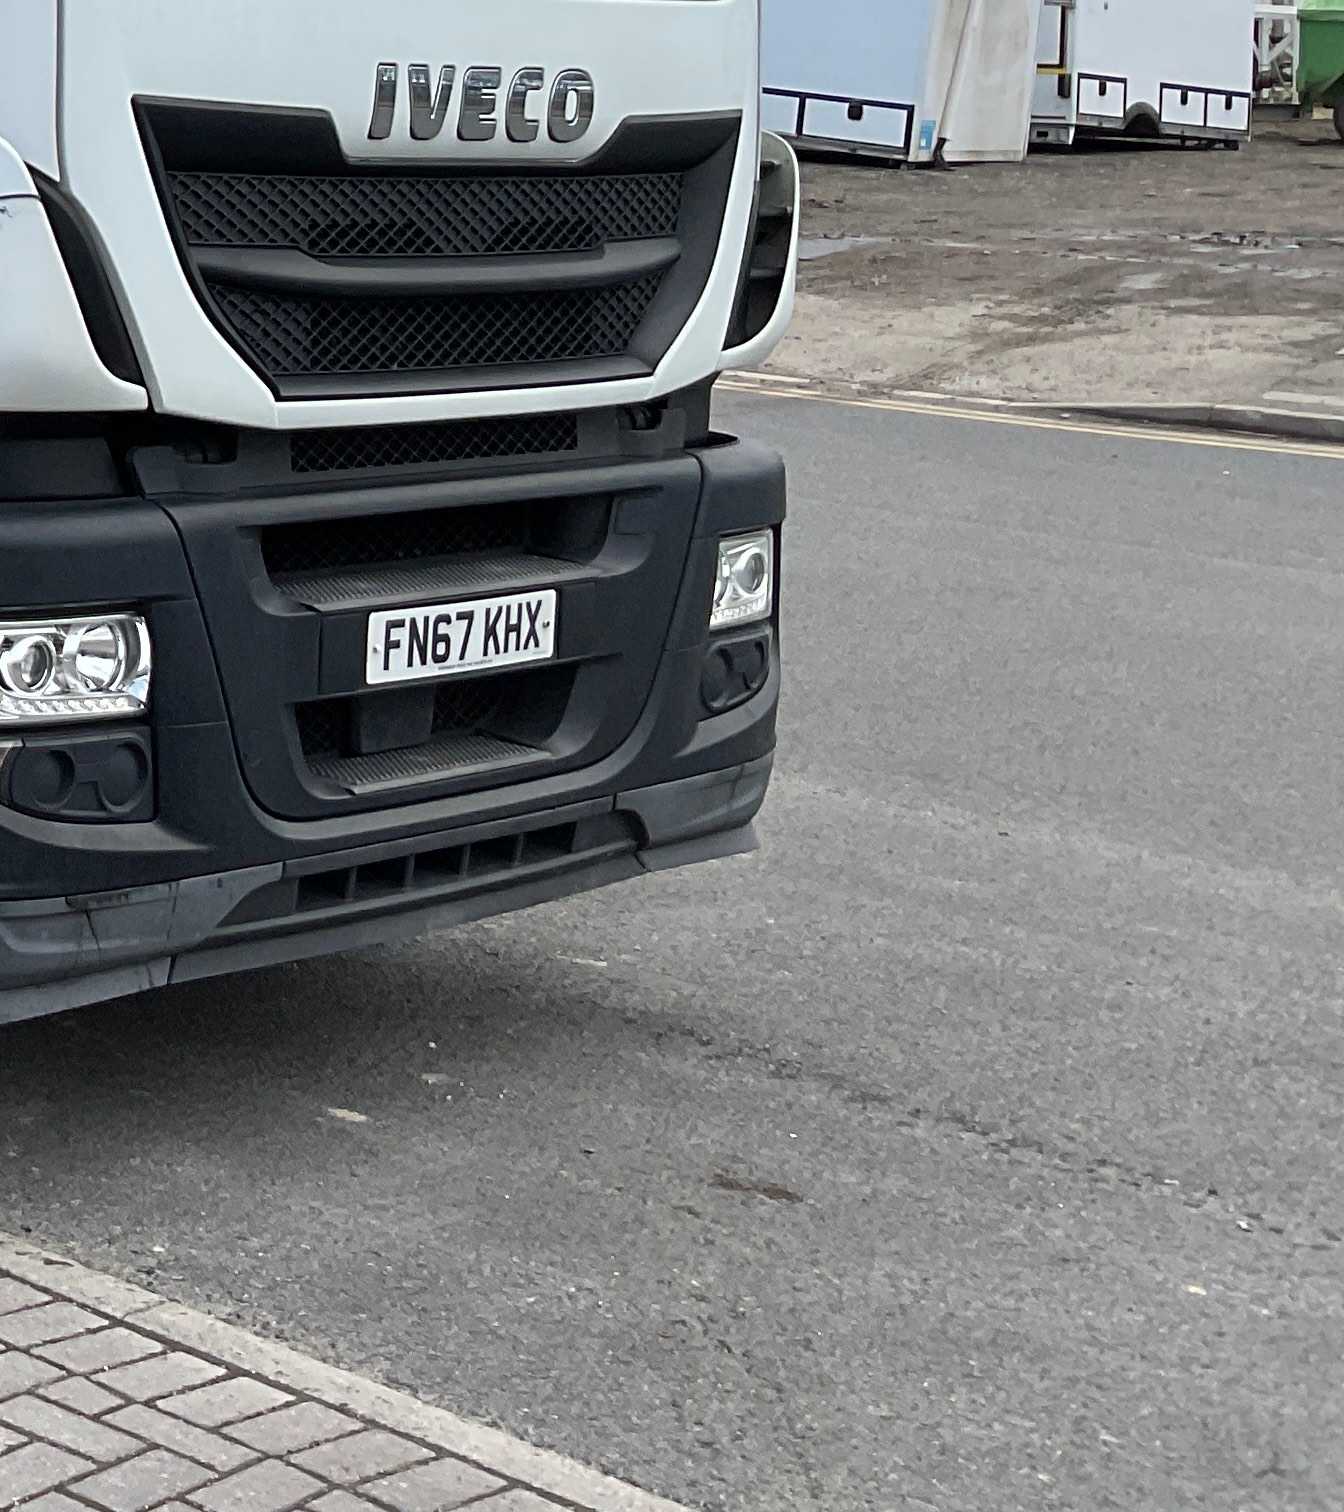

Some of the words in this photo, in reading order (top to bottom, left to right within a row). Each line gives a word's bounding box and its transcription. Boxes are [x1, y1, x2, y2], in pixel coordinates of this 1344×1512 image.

[367, 62, 595, 144] IVECO
[383, 609, 475, 671] FN67
[482, 599, 543, 657] KHX
